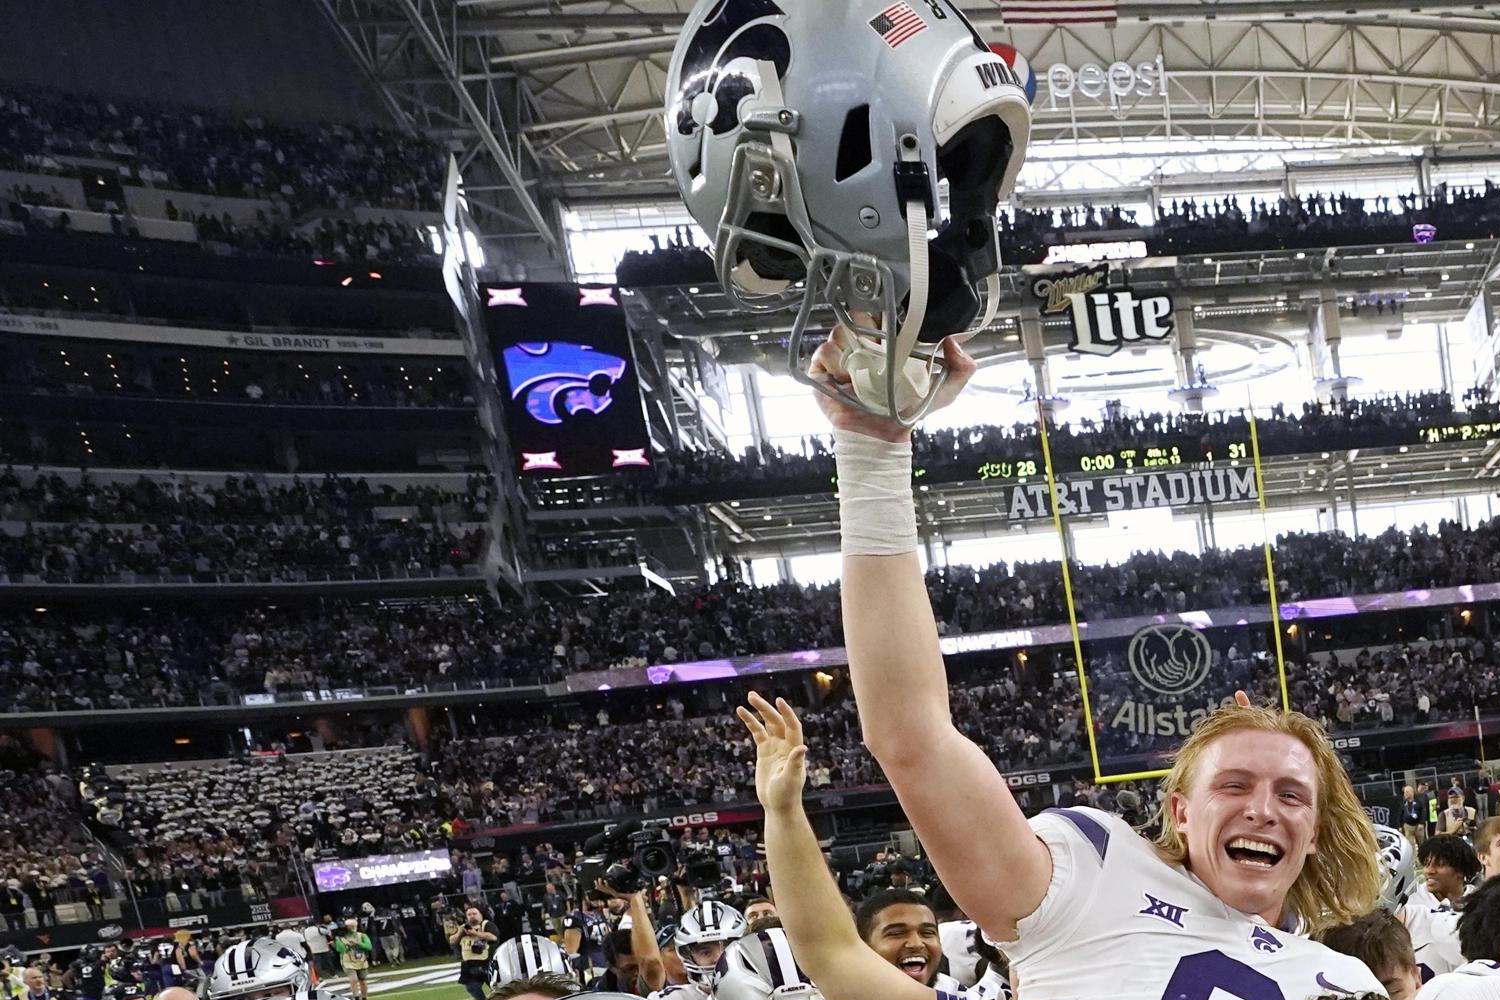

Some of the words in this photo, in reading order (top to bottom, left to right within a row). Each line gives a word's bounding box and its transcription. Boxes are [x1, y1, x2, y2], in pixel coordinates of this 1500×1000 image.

[1048, 53, 1169, 111] pepsi
[1033, 271, 1106, 313] Miller
[1063, 291, 1171, 357] Lite
[243, 334, 270, 348] GIL
[271, 336, 331, 349] BRANDT
[1080, 454, 1115, 472] 0:00
[1228, 442, 1247, 459] 31
[1016, 460, 1037, 477] 28
[1008, 478, 1094, 519] AT&T
[1103, 466, 1260, 512] STADIUM
[168, 914, 209, 928] ESPN
[1139, 893, 1189, 929] XII
